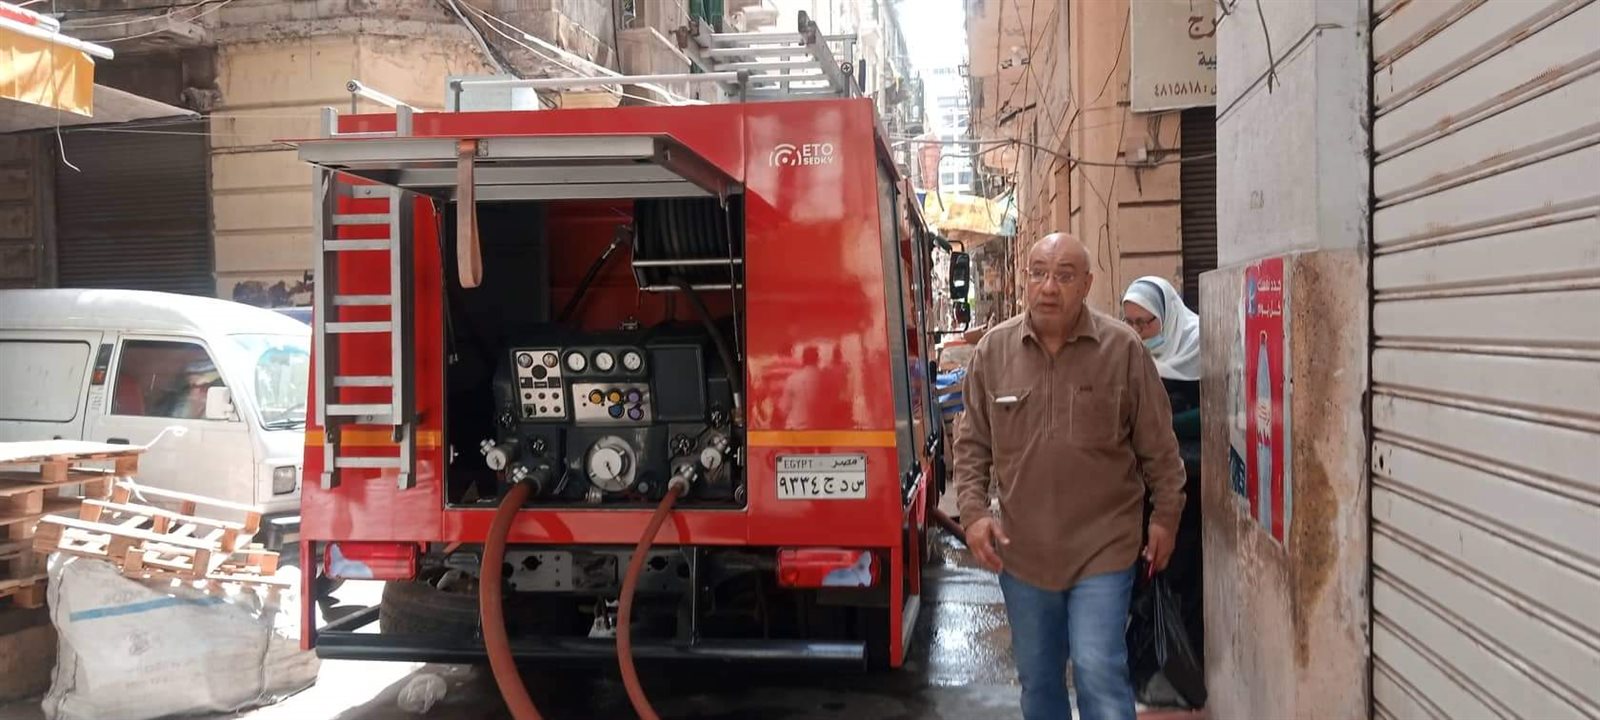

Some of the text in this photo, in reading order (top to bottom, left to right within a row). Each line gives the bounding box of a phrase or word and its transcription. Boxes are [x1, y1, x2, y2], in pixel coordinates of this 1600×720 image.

[802, 143, 834, 157] ETO
[803, 156, 834, 166] SEDKY
[784, 459, 813, 469] EGYPT
[831, 458, 858, 469] مصر
